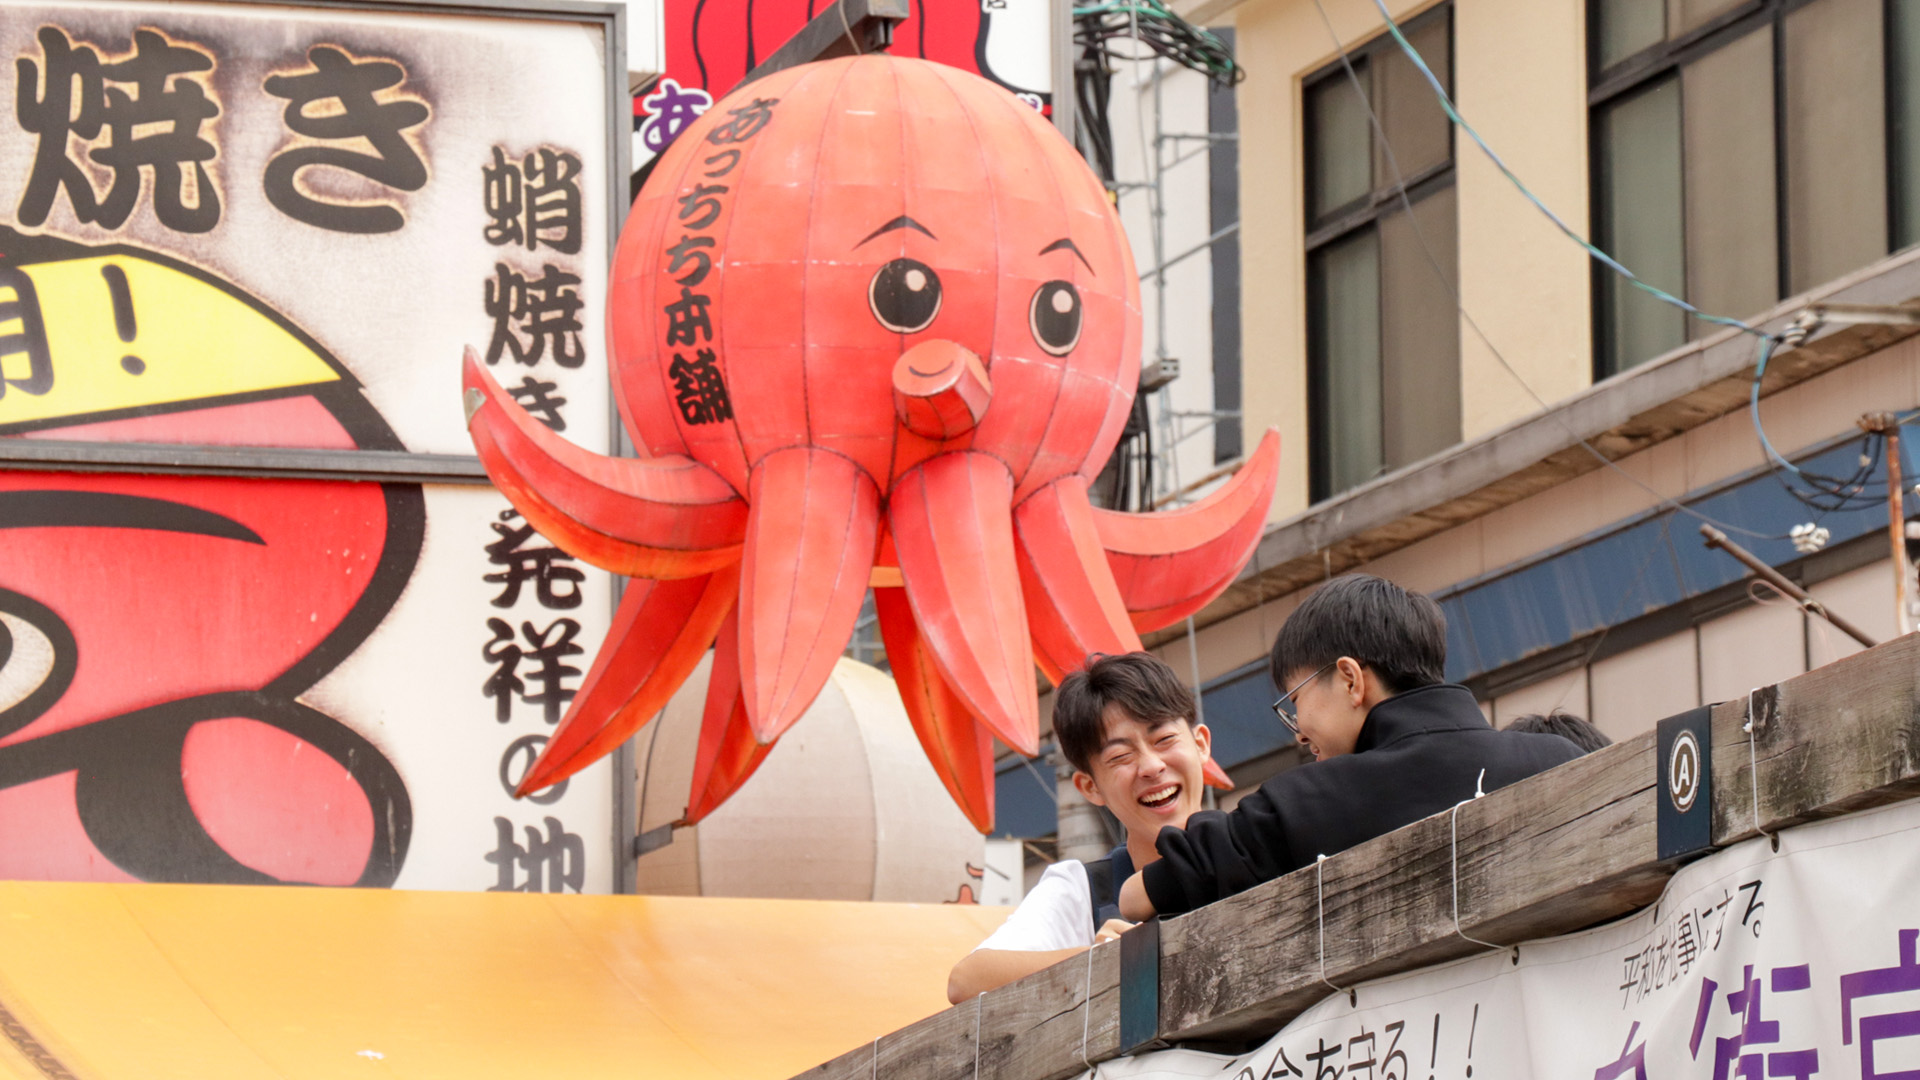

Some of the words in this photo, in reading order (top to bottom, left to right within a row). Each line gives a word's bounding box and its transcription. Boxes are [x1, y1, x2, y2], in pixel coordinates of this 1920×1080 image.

[16, 24, 430, 234] 焼き
[663, 97, 780, 426] あっちち本舗
[1619, 879, 1765, 1010] 平和を仕事にする
